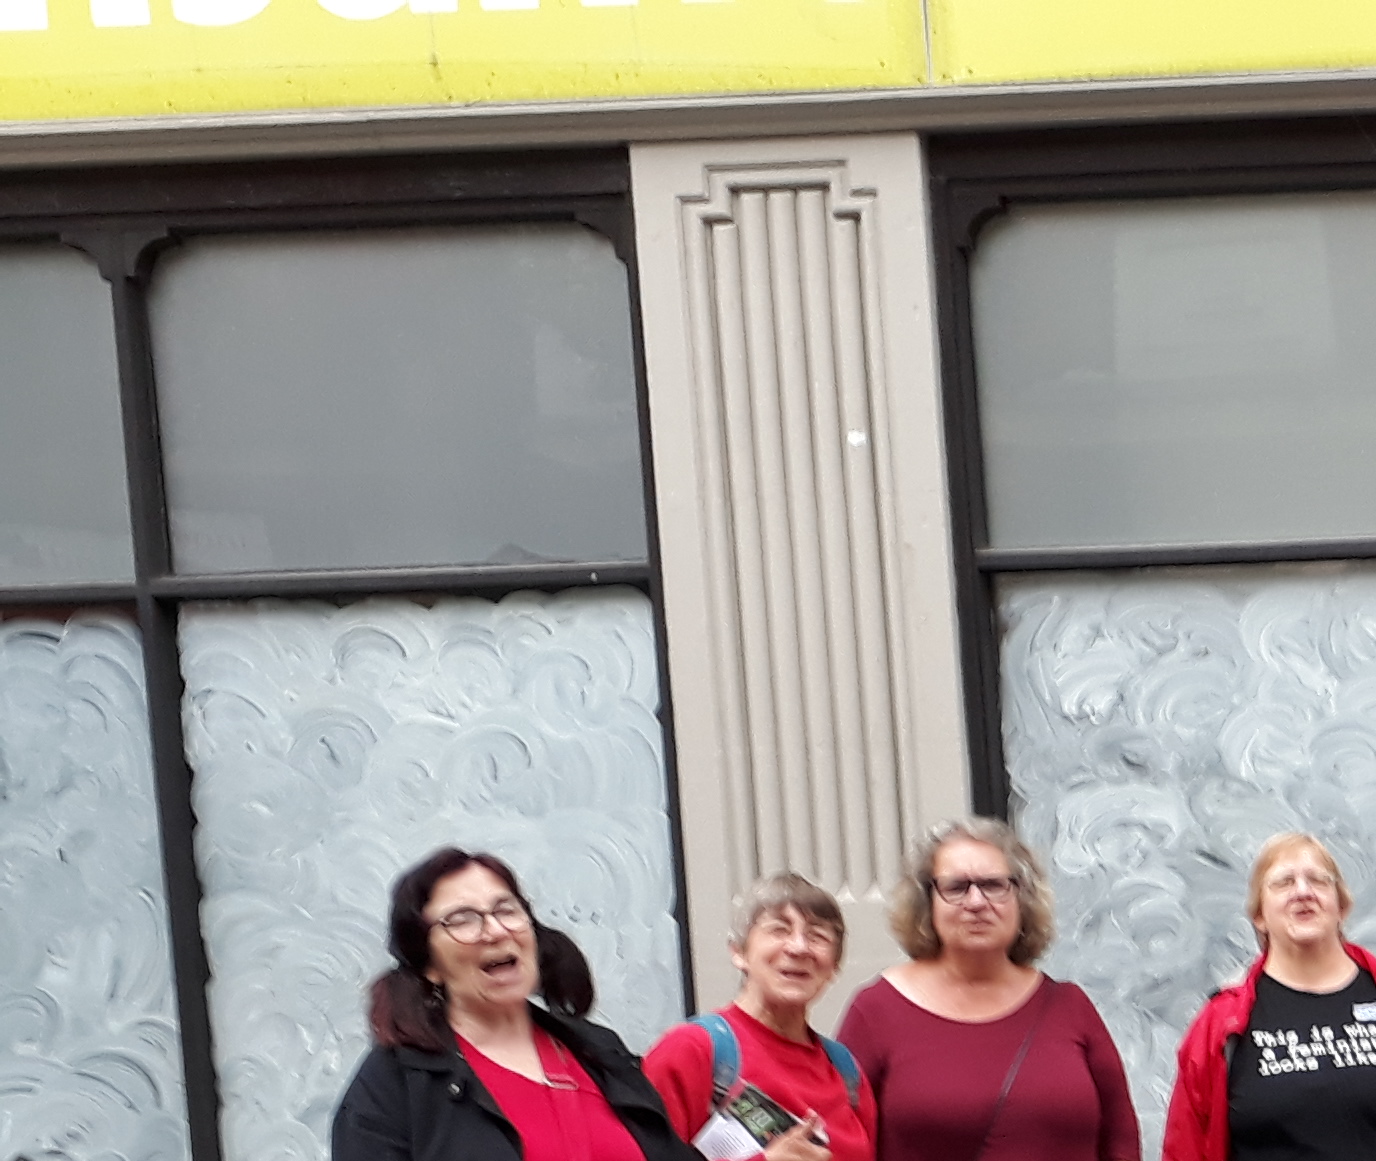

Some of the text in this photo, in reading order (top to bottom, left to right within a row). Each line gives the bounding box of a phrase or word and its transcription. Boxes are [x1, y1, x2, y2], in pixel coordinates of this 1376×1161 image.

[1252, 1029, 1299, 1047] This
[1310, 1024, 1334, 1042] is
[1258, 1054, 1319, 1076] looks
